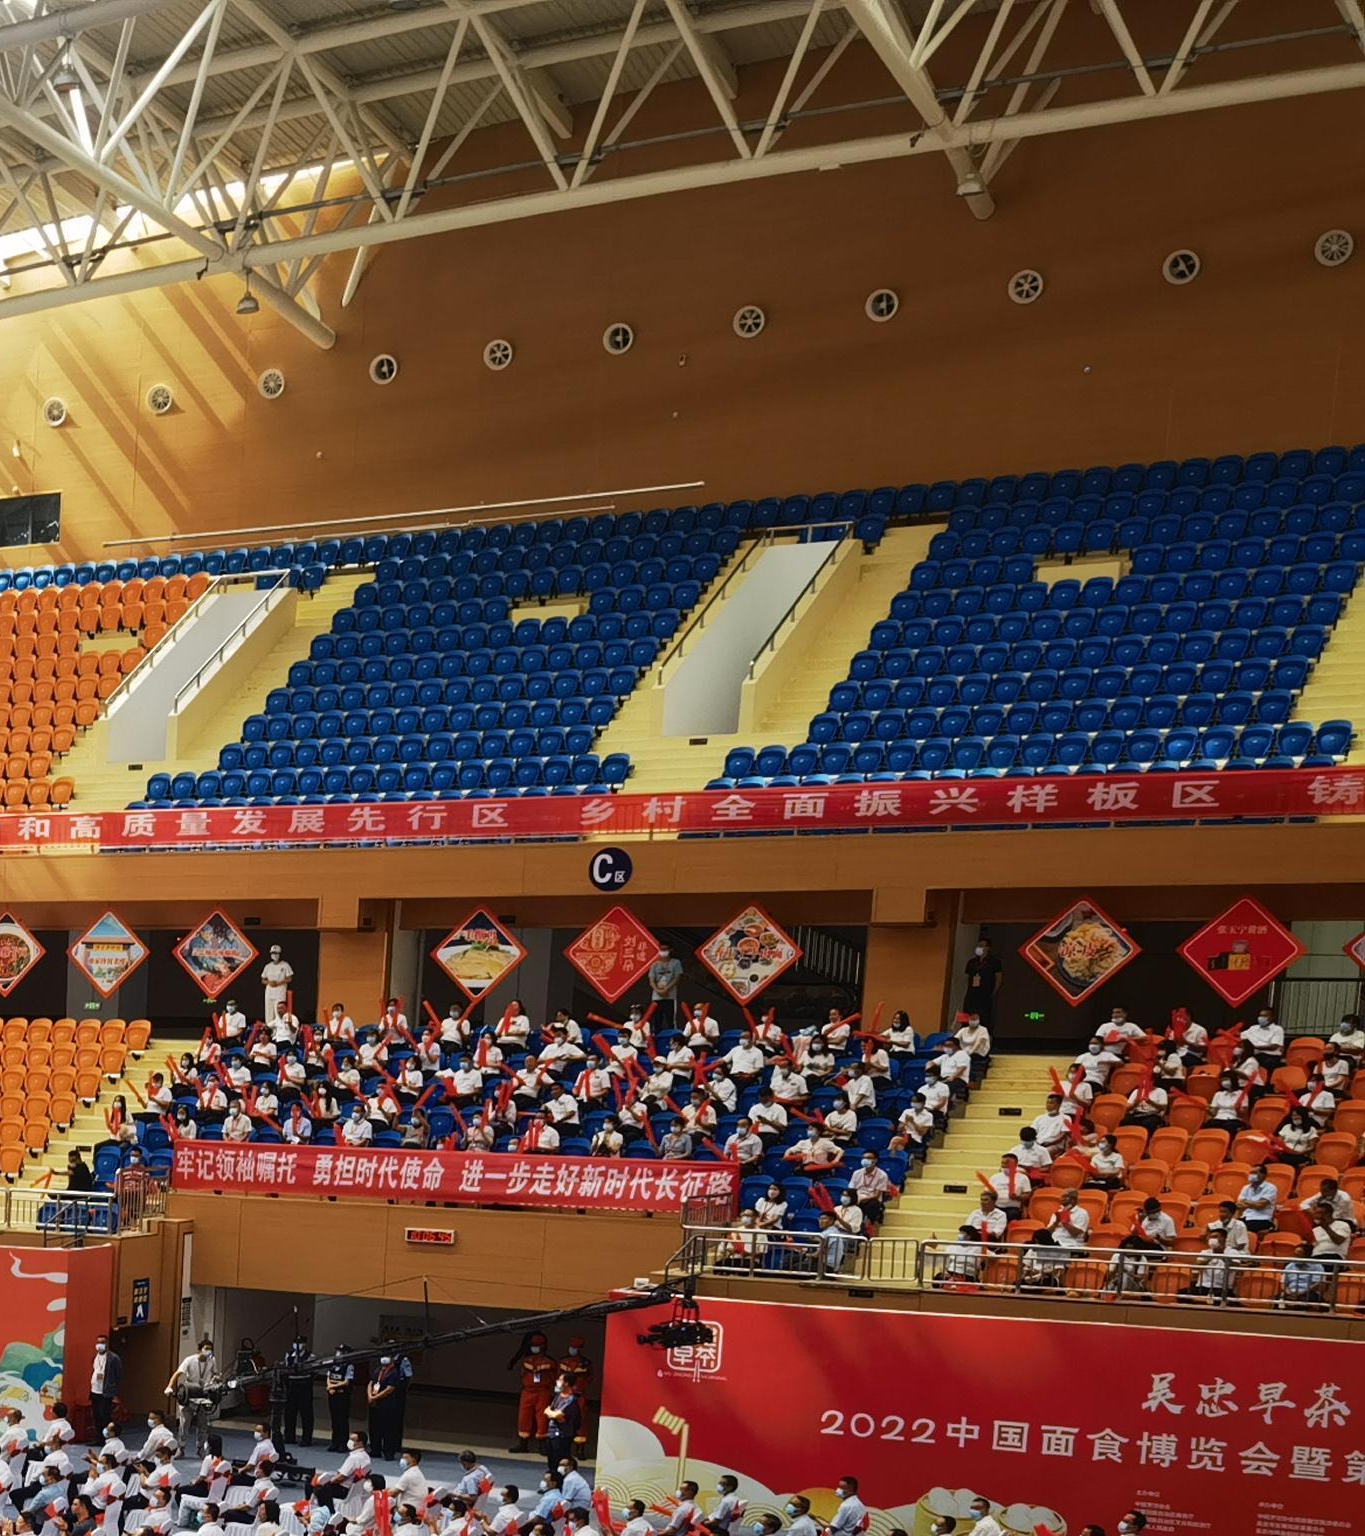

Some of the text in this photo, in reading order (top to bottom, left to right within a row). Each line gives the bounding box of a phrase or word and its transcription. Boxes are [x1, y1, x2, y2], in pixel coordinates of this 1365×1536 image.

[581, 779, 1220, 826] 乡村全面振兴样板区
[176, 1148, 736, 1207] 牢记领袖嘱托 勇担时代使命 进一步走好新时代长征路
[1140, 1371, 1352, 1430] 吴忠早茶
